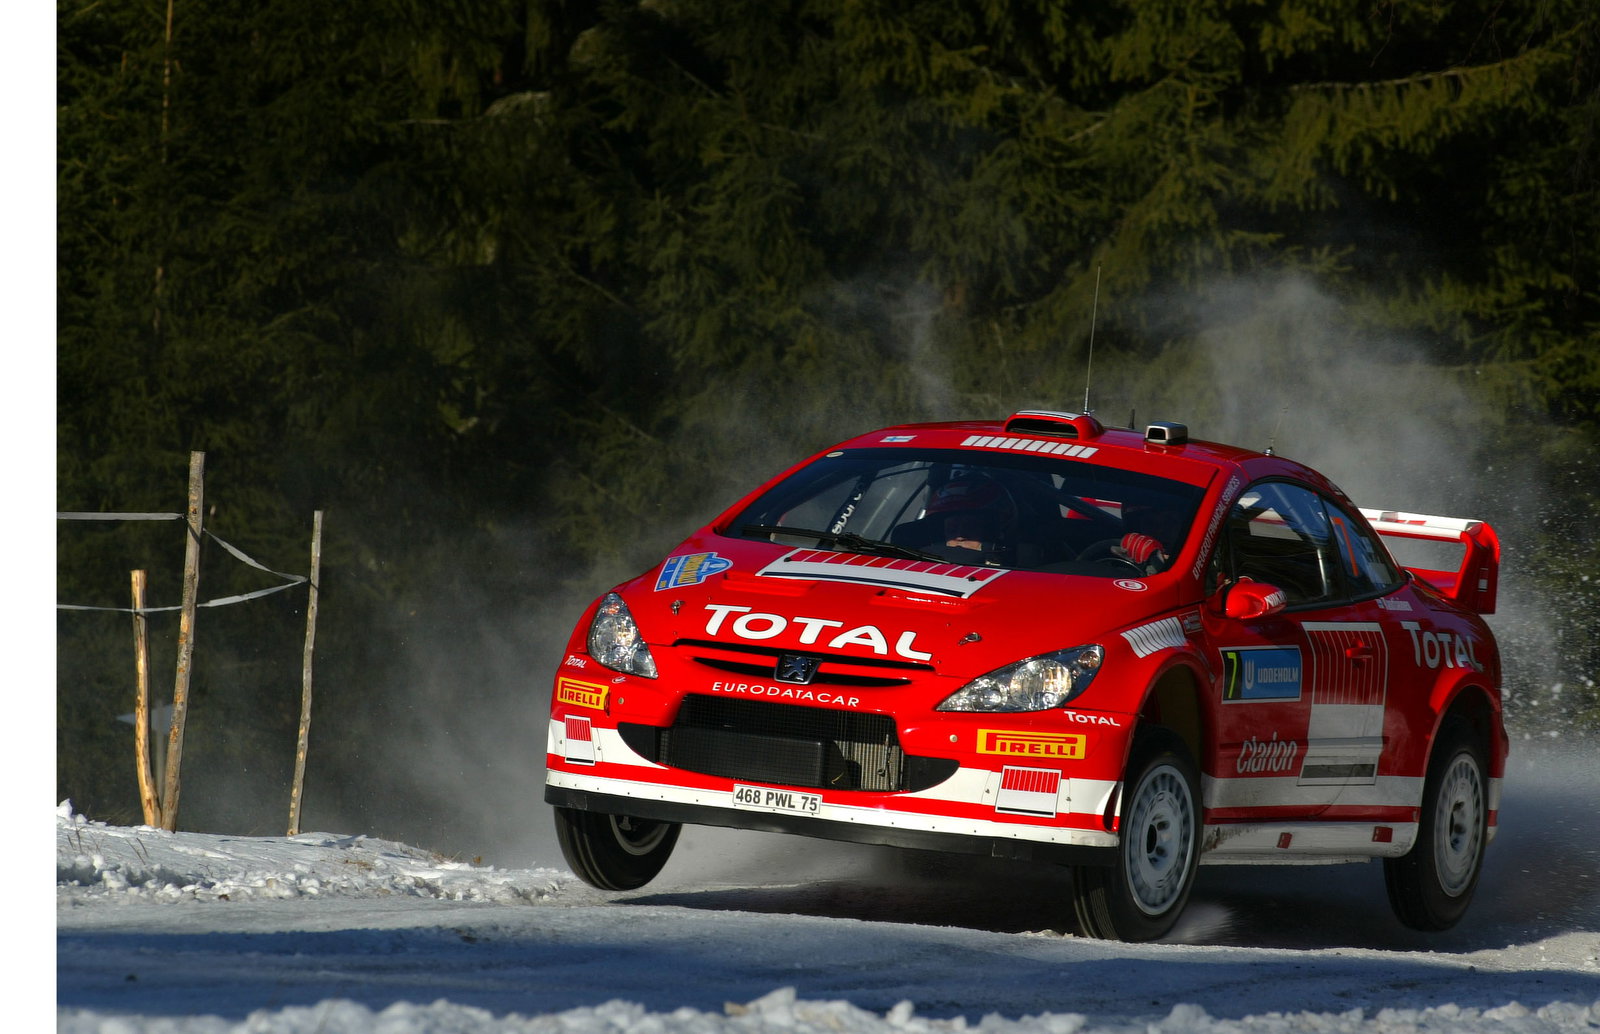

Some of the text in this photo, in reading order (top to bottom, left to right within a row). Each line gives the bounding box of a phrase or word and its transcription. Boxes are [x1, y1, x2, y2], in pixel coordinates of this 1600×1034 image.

[704, 604, 934, 662] TOTAL
[1401, 620, 1484, 673] TOTAL
[565, 655, 587, 669] TOTAL
[1227, 652, 1237, 699] 7
[1257, 667, 1299, 683] UDDEHOLM
[560, 680, 603, 706] PIRELLI
[712, 681, 860, 708] EURODATACAR
[1064, 711, 1121, 727] TOTAL
[985, 732, 1078, 756] PIRELLI
[736, 788, 818, 812] 468 PWL 75
